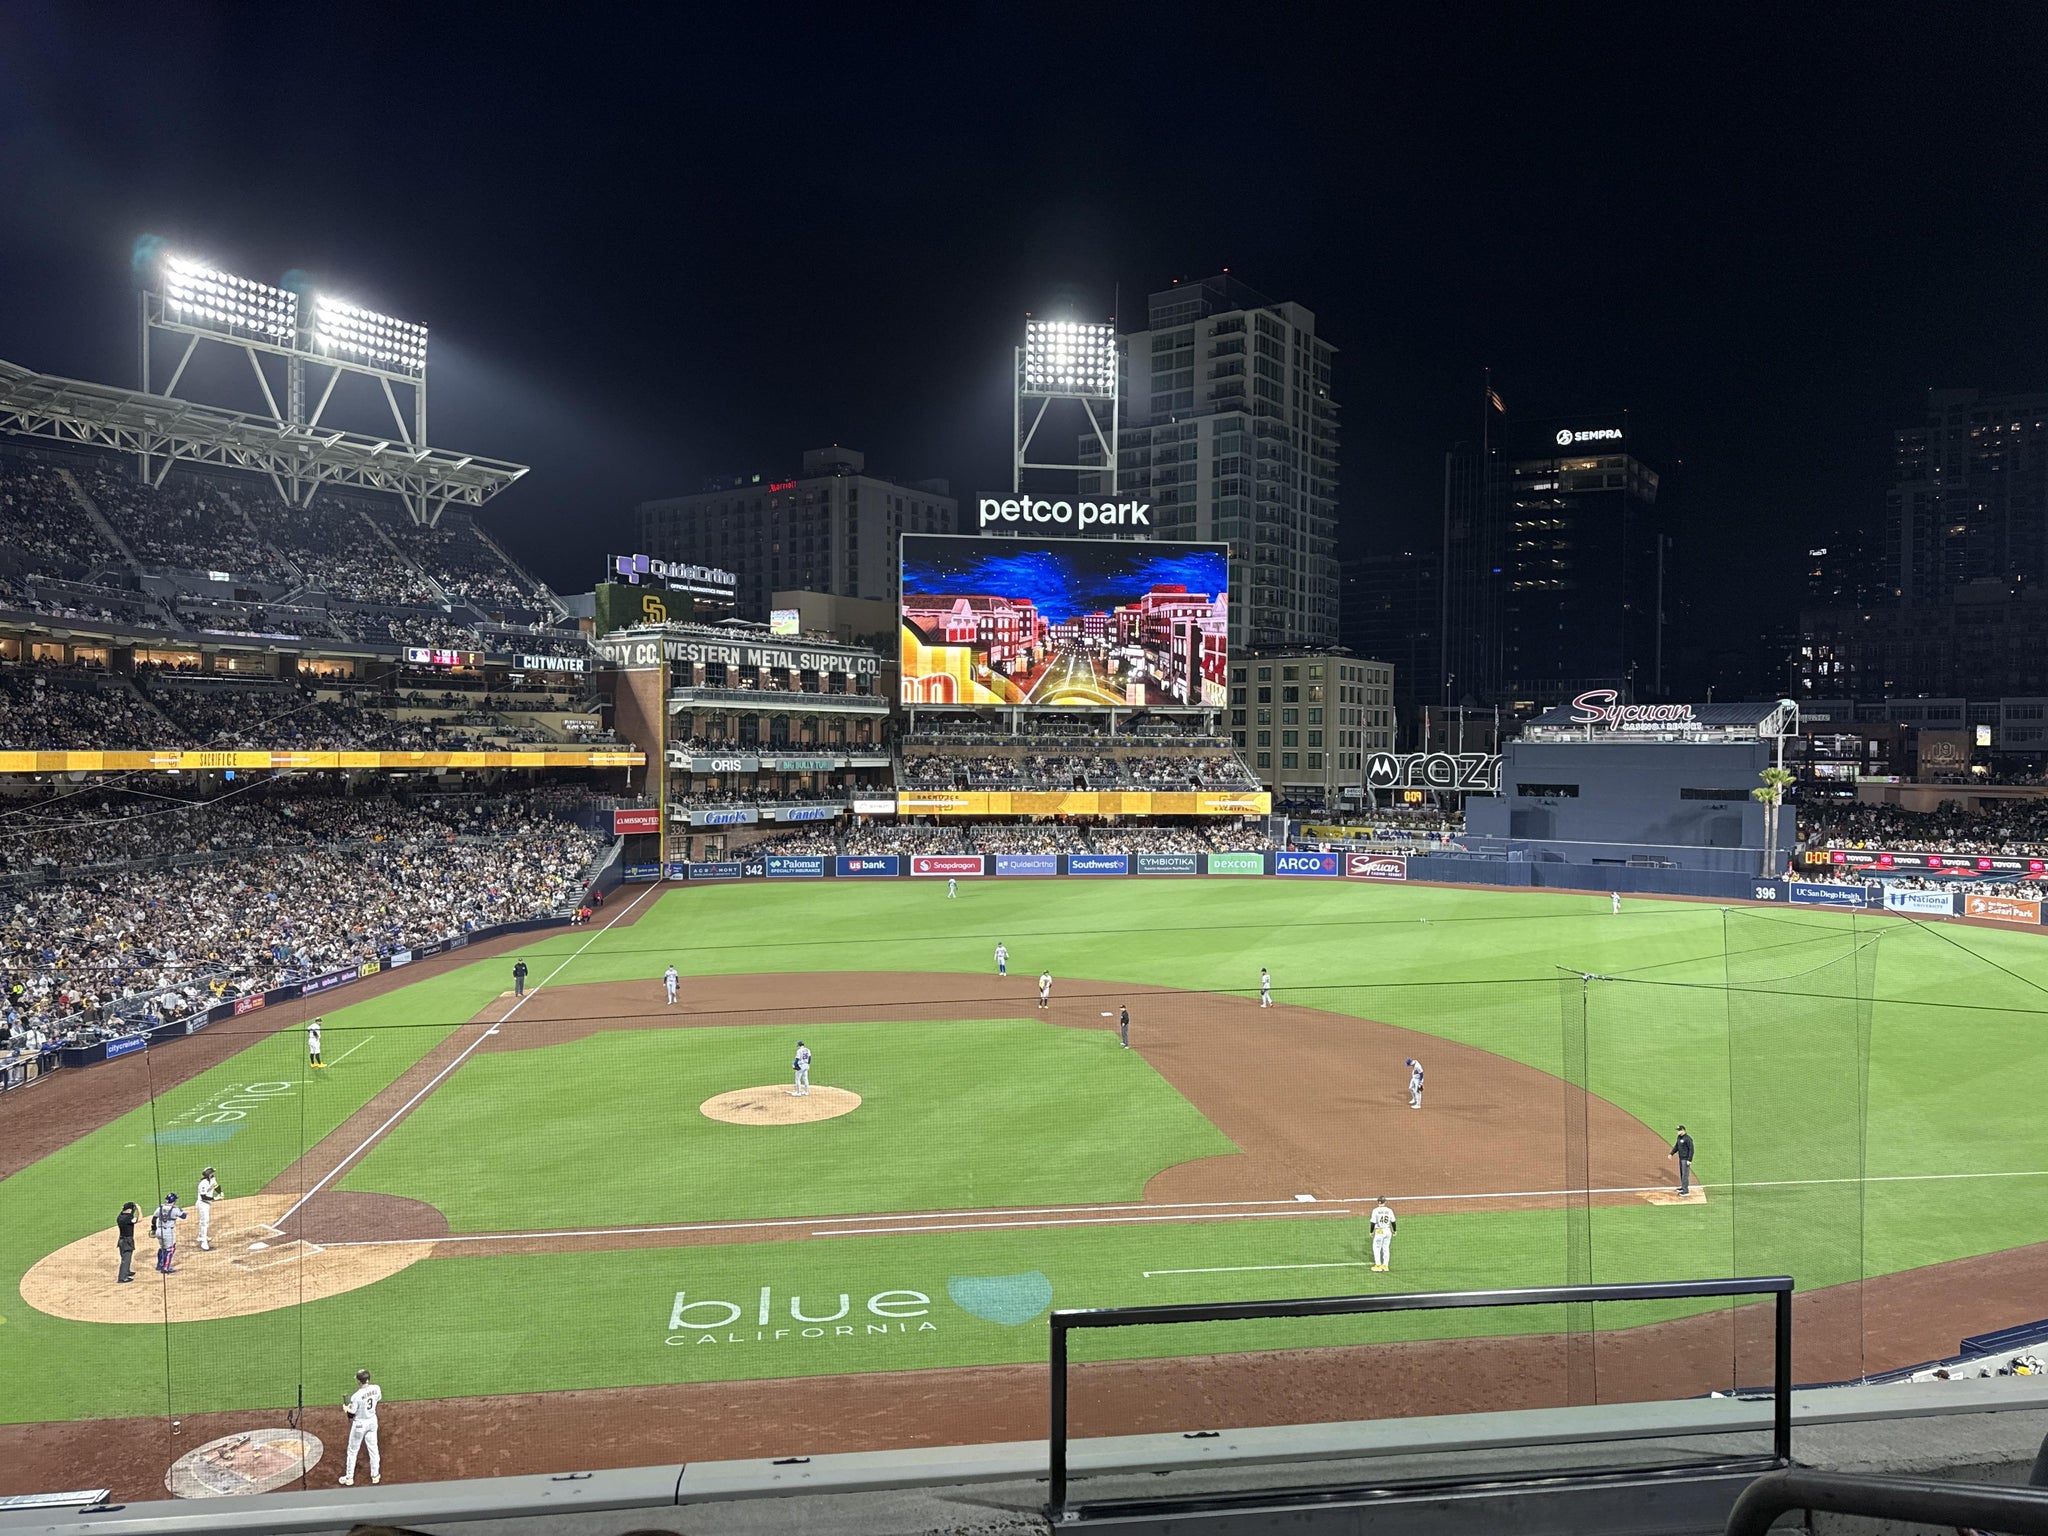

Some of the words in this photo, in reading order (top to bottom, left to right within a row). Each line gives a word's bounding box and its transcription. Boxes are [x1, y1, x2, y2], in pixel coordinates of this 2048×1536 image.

[1574, 429, 1622, 441] SEMPRA
[768, 481, 797, 493] Marriott
[979, 495, 1073, 527] petco
[1078, 501, 1150, 530] park
[651, 559, 736, 585] QuidelOrtho
[523, 656, 584, 671] CUTWATER
[663, 641, 740, 665] WESTERN
[747, 648, 797, 669] METAL
[800, 653, 852, 673] SUPPLY
[857, 658, 879, 675] CO.
[1570, 689, 1696, 731] Sycuan
[200, 753, 238, 766] SACRIFICE
[711, 759, 742, 771] ORIS
[670, 824, 686, 835] 336
[1140, 858, 1194, 866] CYMBIOTIKA
[1278, 857, 1320, 870] ARCO
[1805, 851, 1830, 864] 0:09
[1893, 857, 1921, 865] TOYOTA
[1941, 859, 1971, 867] TOYOTA
[745, 864, 763, 876] 342
[783, 859, 820, 869] Palomar
[862, 860, 886, 869] bank
[933, 861, 976, 870] Snapdragon
[1010, 860, 1053, 869] QuidelOrtho
[1072, 860, 1118, 869] Southwest
[1350, 856, 1400, 875] Sycuan
[1992, 861, 2022, 869] TOYOTA
[1756, 887, 1776, 900] 396
[1796, 888, 1807, 896] UC
[1807, 889, 1820, 897] San
[1820, 889, 1839, 899] Diego
[1839, 891, 1860, 899] Health
[1908, 894, 1949, 905] National
[2013, 908, 2033, 918] Park
[108, 1039, 140, 1053] citycruises
[667, 1286, 932, 1330] blue
[664, 1321, 938, 1347] CALIFORNIA
[366, 1397, 373, 1410] 3
